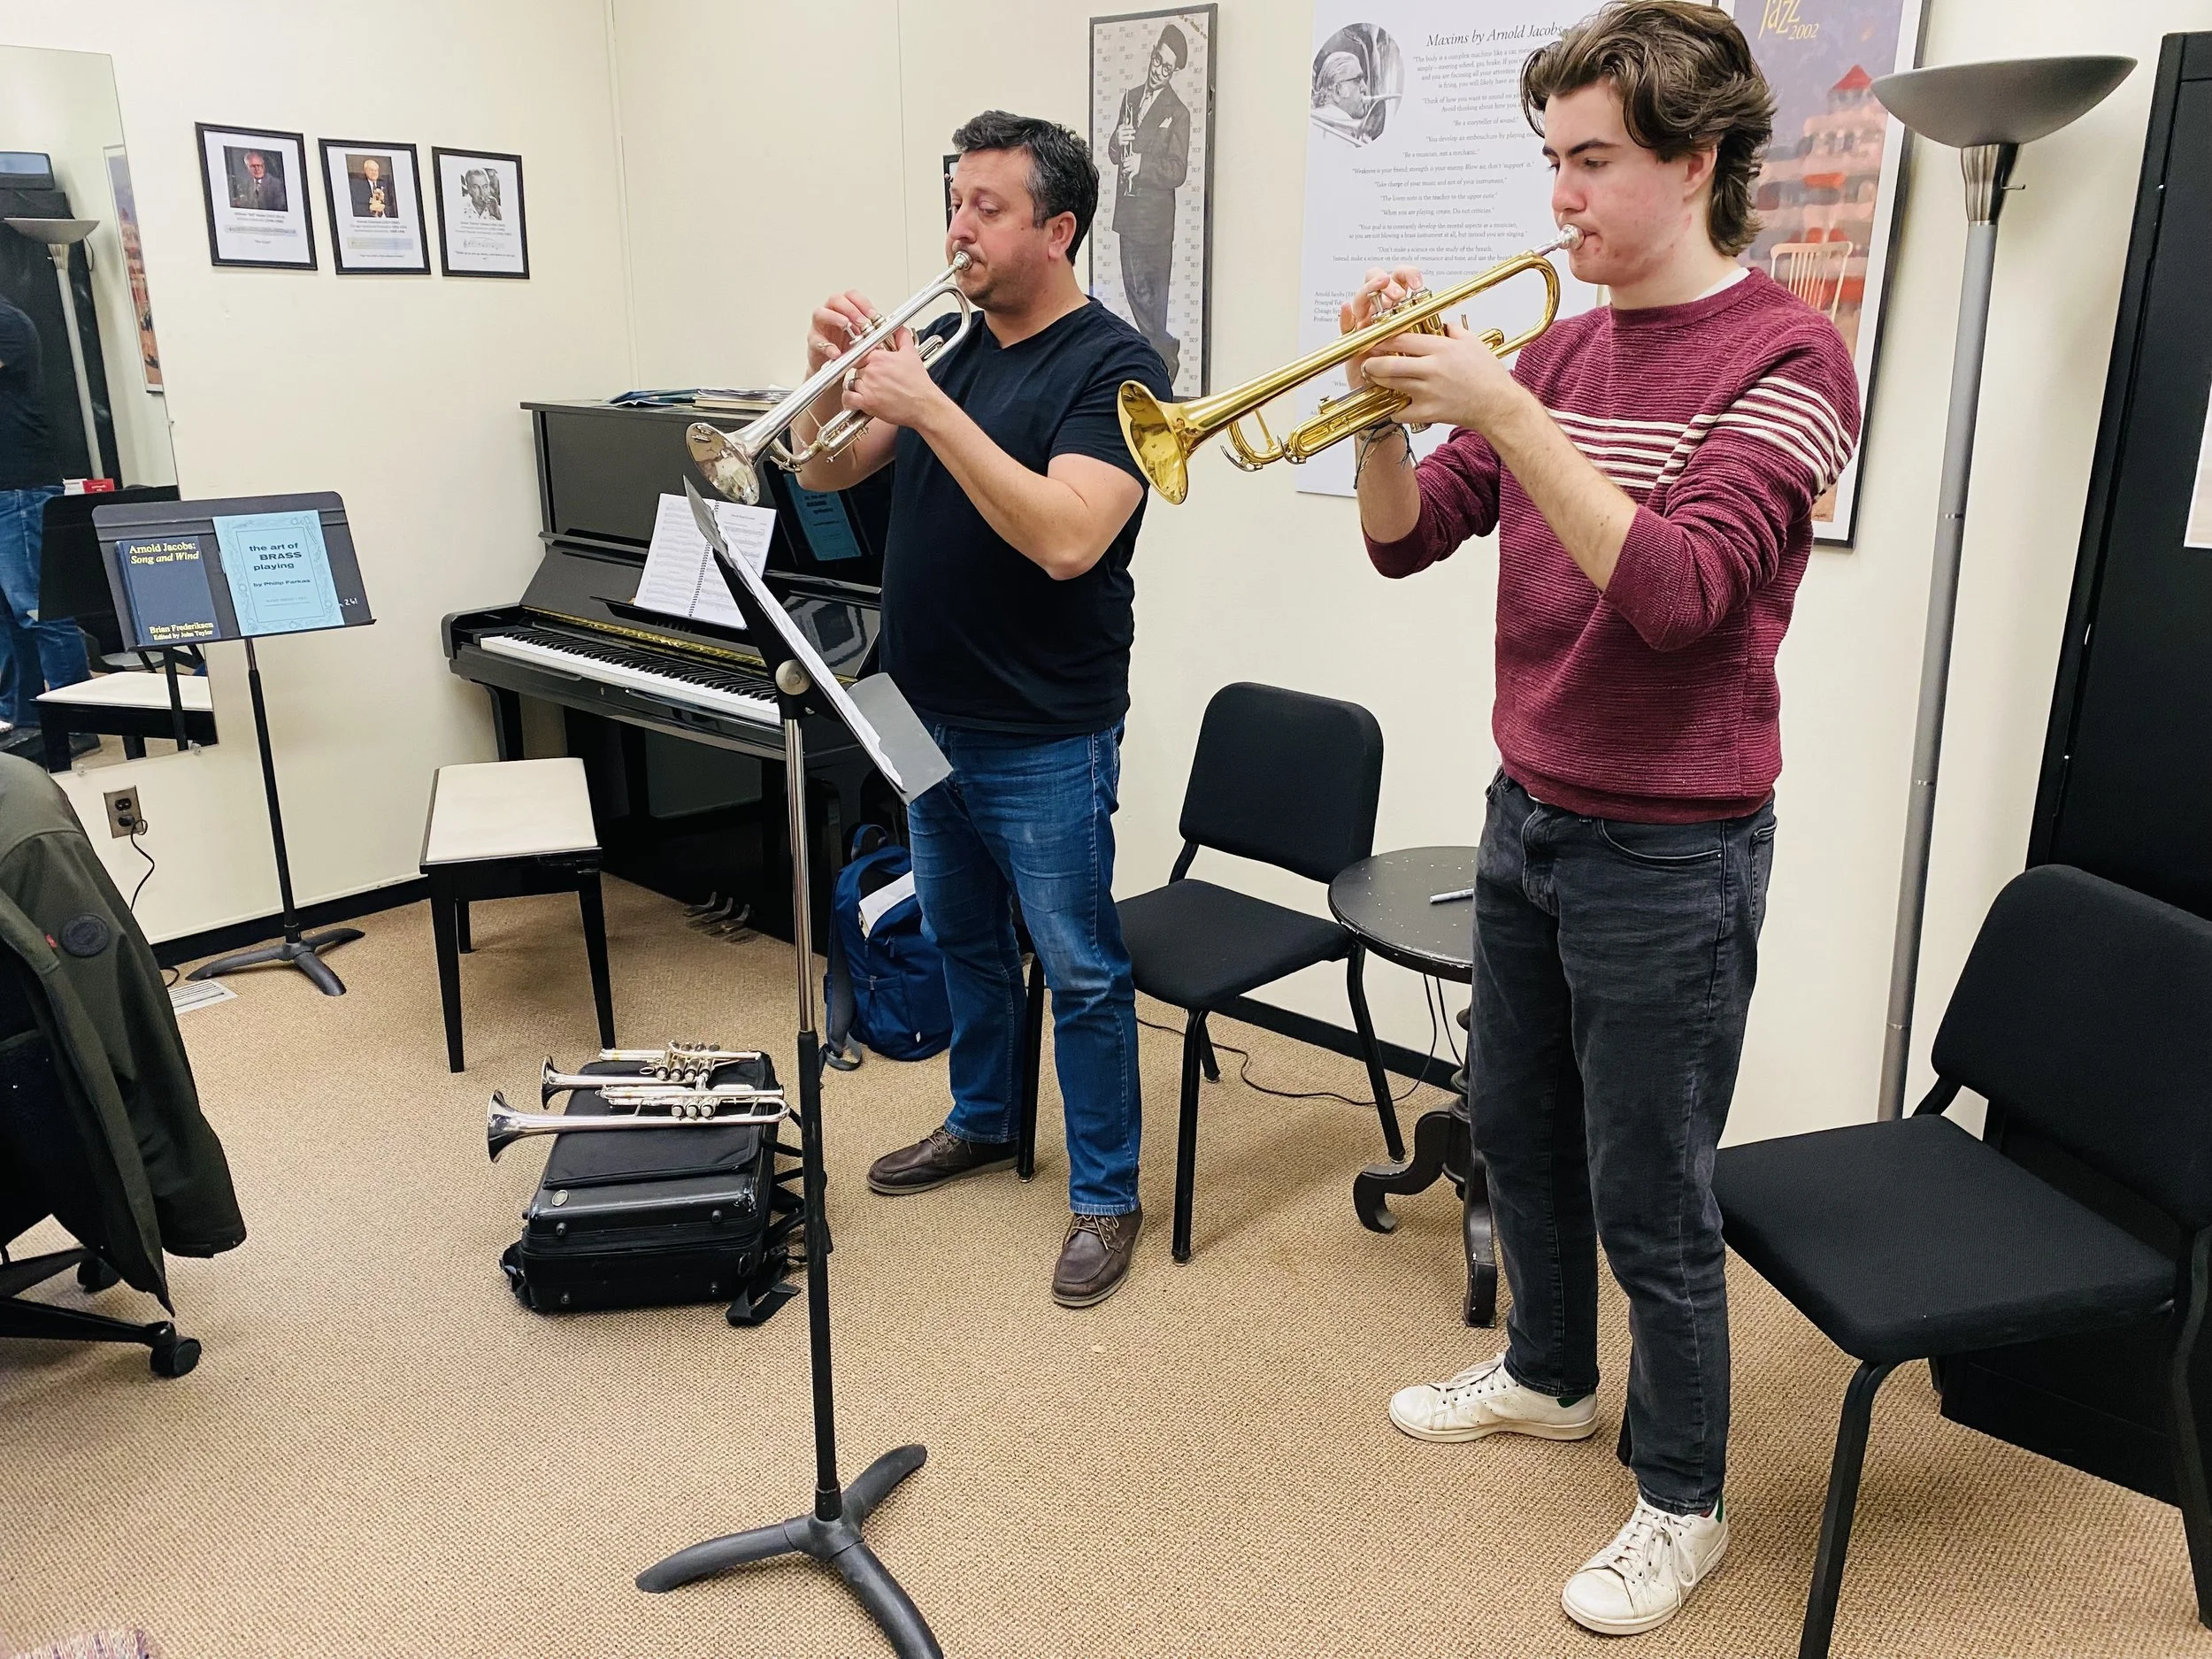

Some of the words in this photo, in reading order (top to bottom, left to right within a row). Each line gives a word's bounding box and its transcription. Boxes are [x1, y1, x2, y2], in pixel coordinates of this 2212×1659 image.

[1426, 34, 1469, 46] Maxims
[1472, 30, 1485, 45] by
[1486, 25, 1525, 42] Arnold
[1527, 21, 1563, 39] Jacobs
[1788, 23, 1819, 40] 2002
[129, 543, 161, 554] Arnold
[163, 541, 196, 552] Jacobs:
[131, 556, 154, 565] Song
[156, 553, 173, 563] and
[175, 551, 199, 561] Wind
[260, 552, 302, 561] BRASS
[253, 563, 295, 572] playing
[171, 622, 213, 632] Frederiksen
